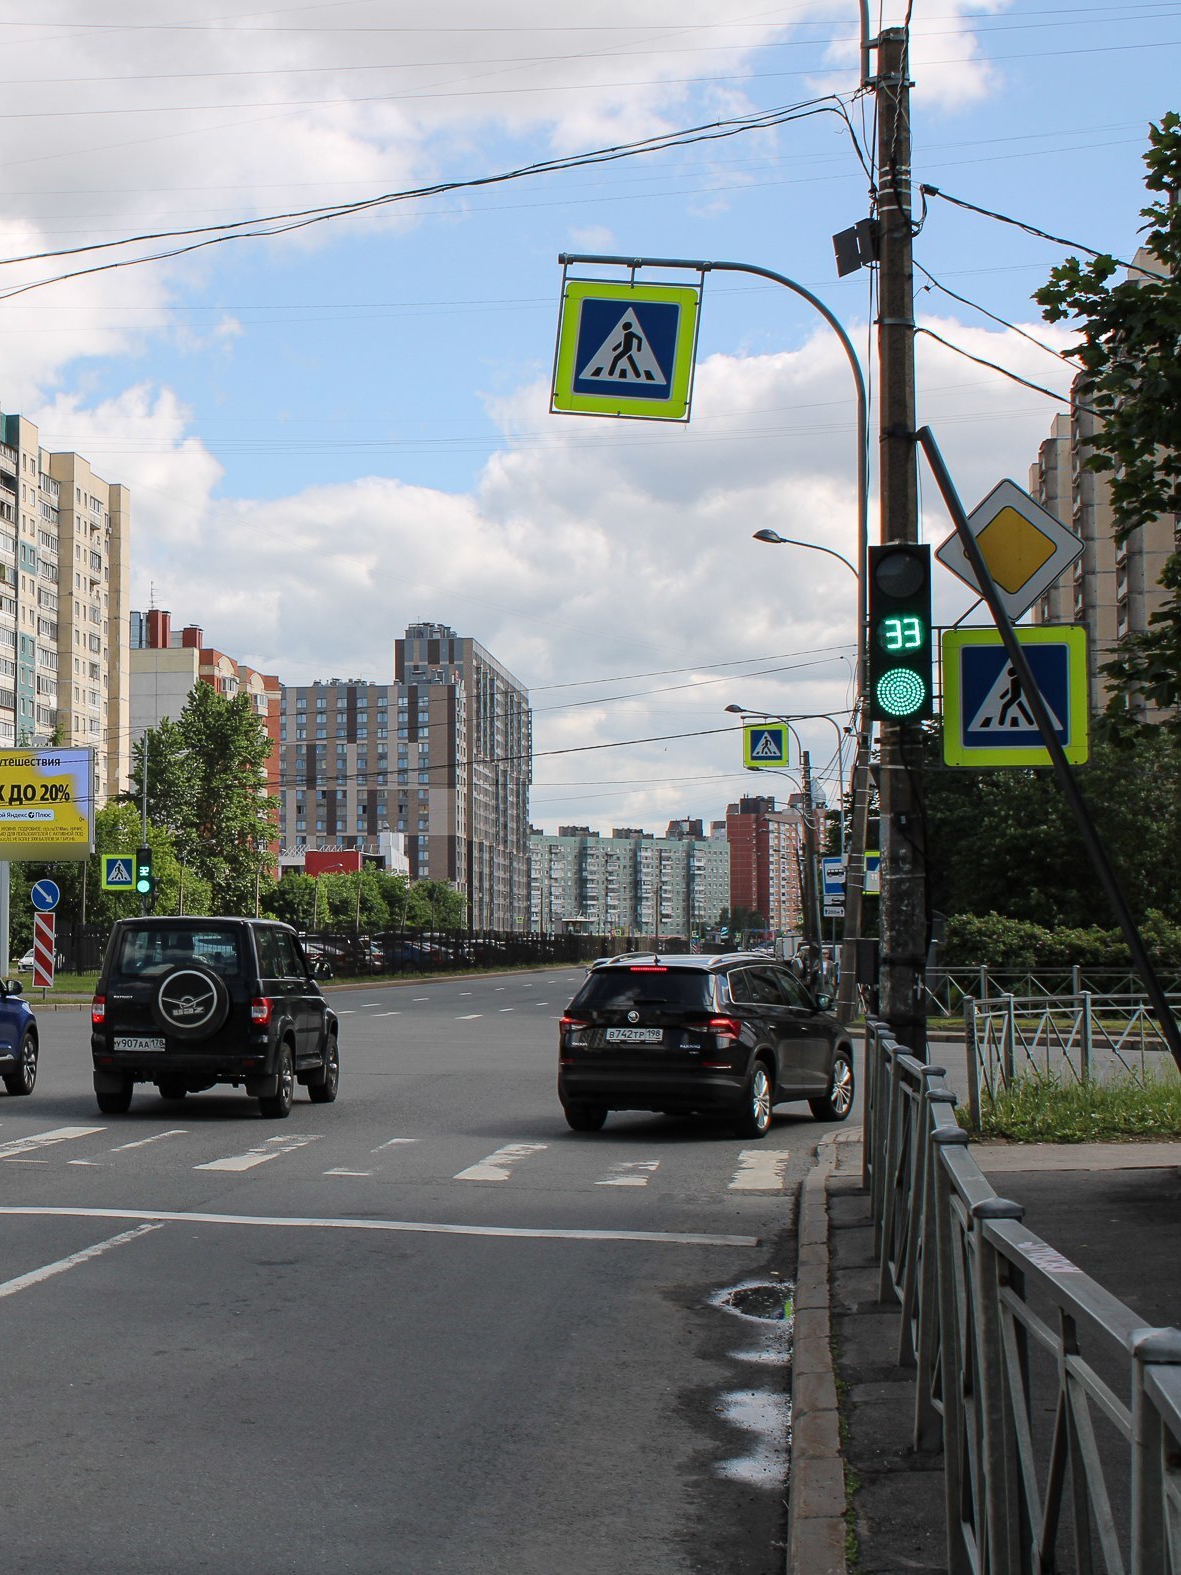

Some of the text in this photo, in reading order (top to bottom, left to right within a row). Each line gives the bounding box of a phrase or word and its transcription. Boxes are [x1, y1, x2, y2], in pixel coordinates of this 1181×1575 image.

[885, 617, 921, 649] 33
[8, 784, 37, 806] ДО
[40, 783, 70, 802] 20%
[6, 812, 28, 820] Яндекс
